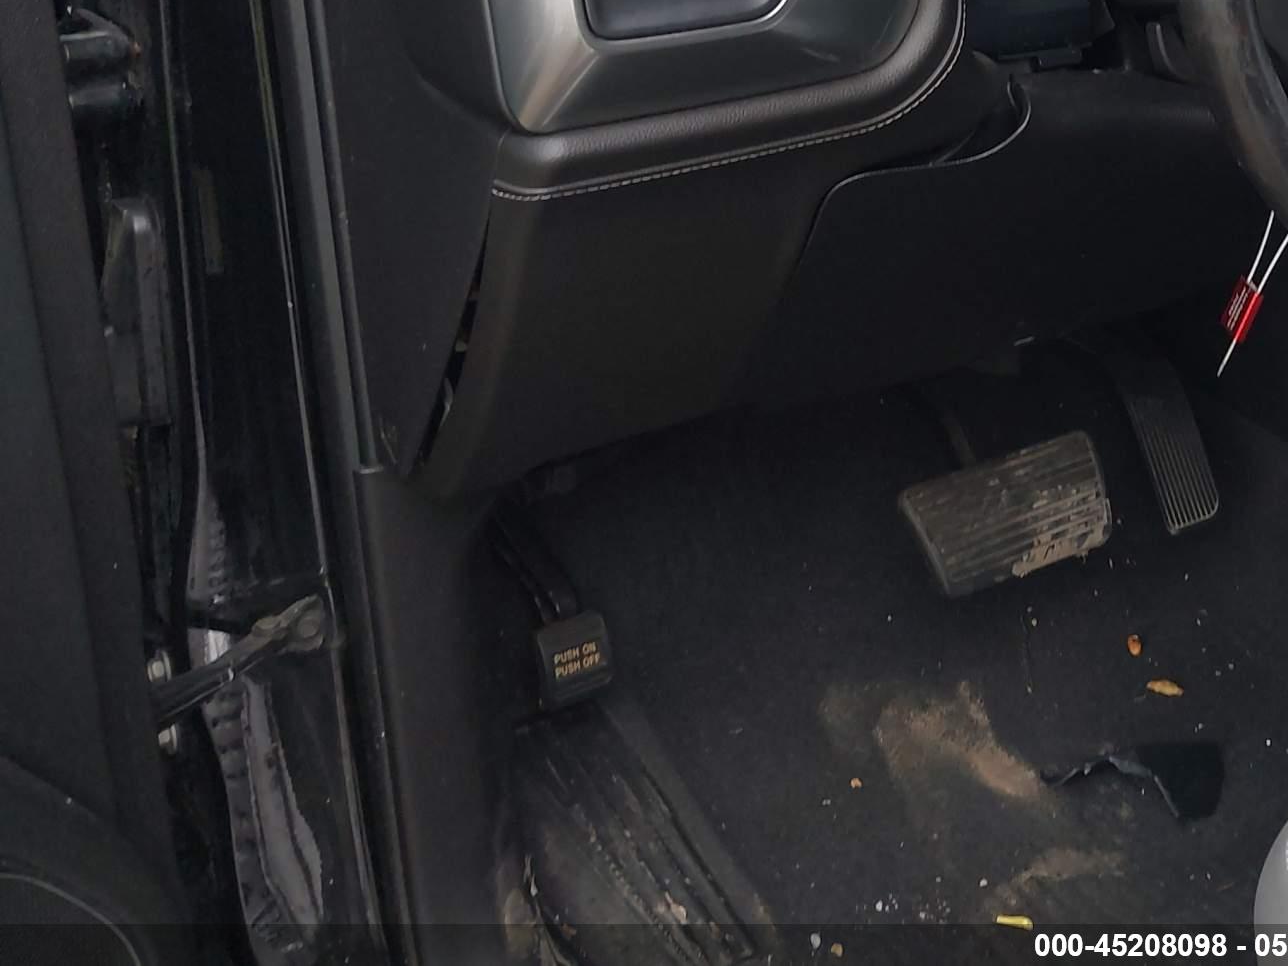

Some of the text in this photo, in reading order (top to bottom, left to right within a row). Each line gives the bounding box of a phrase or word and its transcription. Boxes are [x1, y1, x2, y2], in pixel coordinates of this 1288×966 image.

[554, 641, 597, 665] PUSH ON
[555, 652, 601, 679] PUSH OFF
